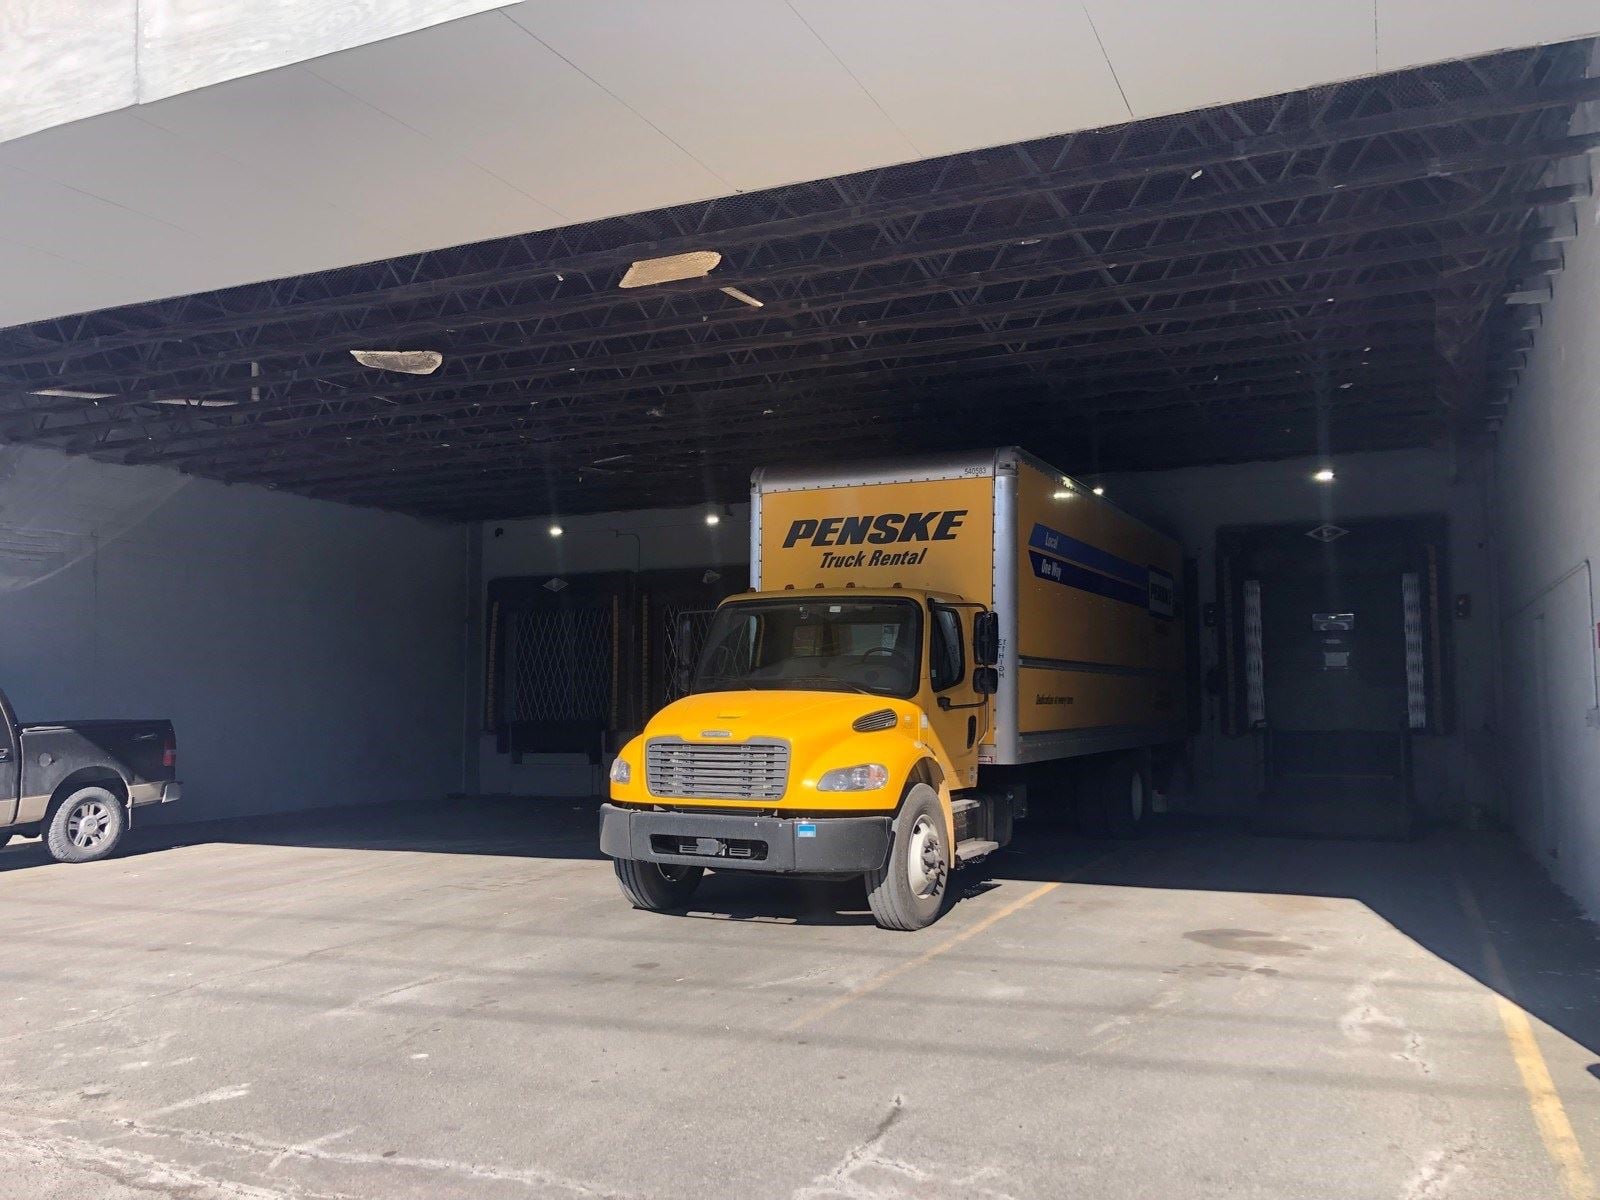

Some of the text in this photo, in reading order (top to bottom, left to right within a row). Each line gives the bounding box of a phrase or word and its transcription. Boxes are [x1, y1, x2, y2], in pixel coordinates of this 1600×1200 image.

[782, 510, 968, 548] PENSKE
[1044, 530, 1059, 550] Local
[820, 548, 928, 569] Truck Rental
